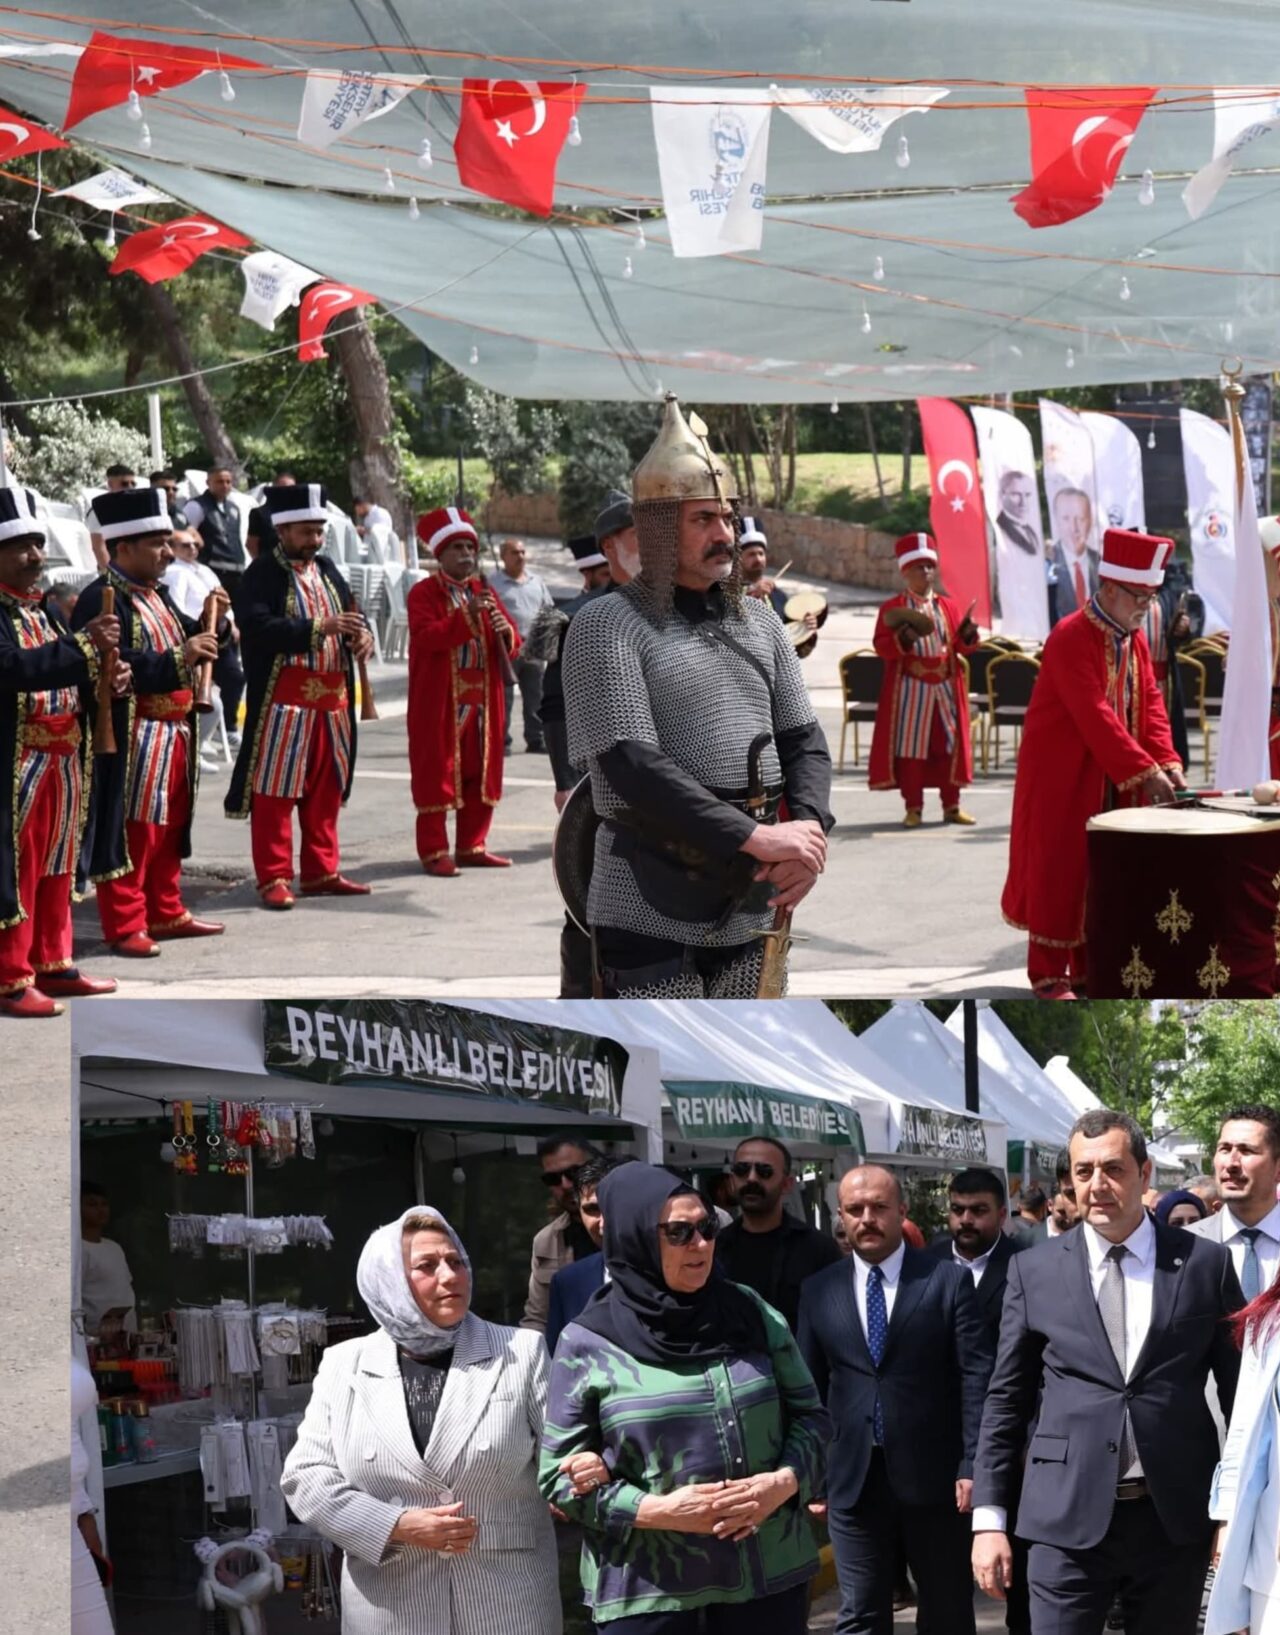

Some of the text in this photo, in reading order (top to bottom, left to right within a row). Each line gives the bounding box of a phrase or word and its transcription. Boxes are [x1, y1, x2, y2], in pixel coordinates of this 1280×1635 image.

[286, 1006, 611, 1100] REYHANLI BELEDİYESİ
[677, 1097, 765, 1126] REYHANI
